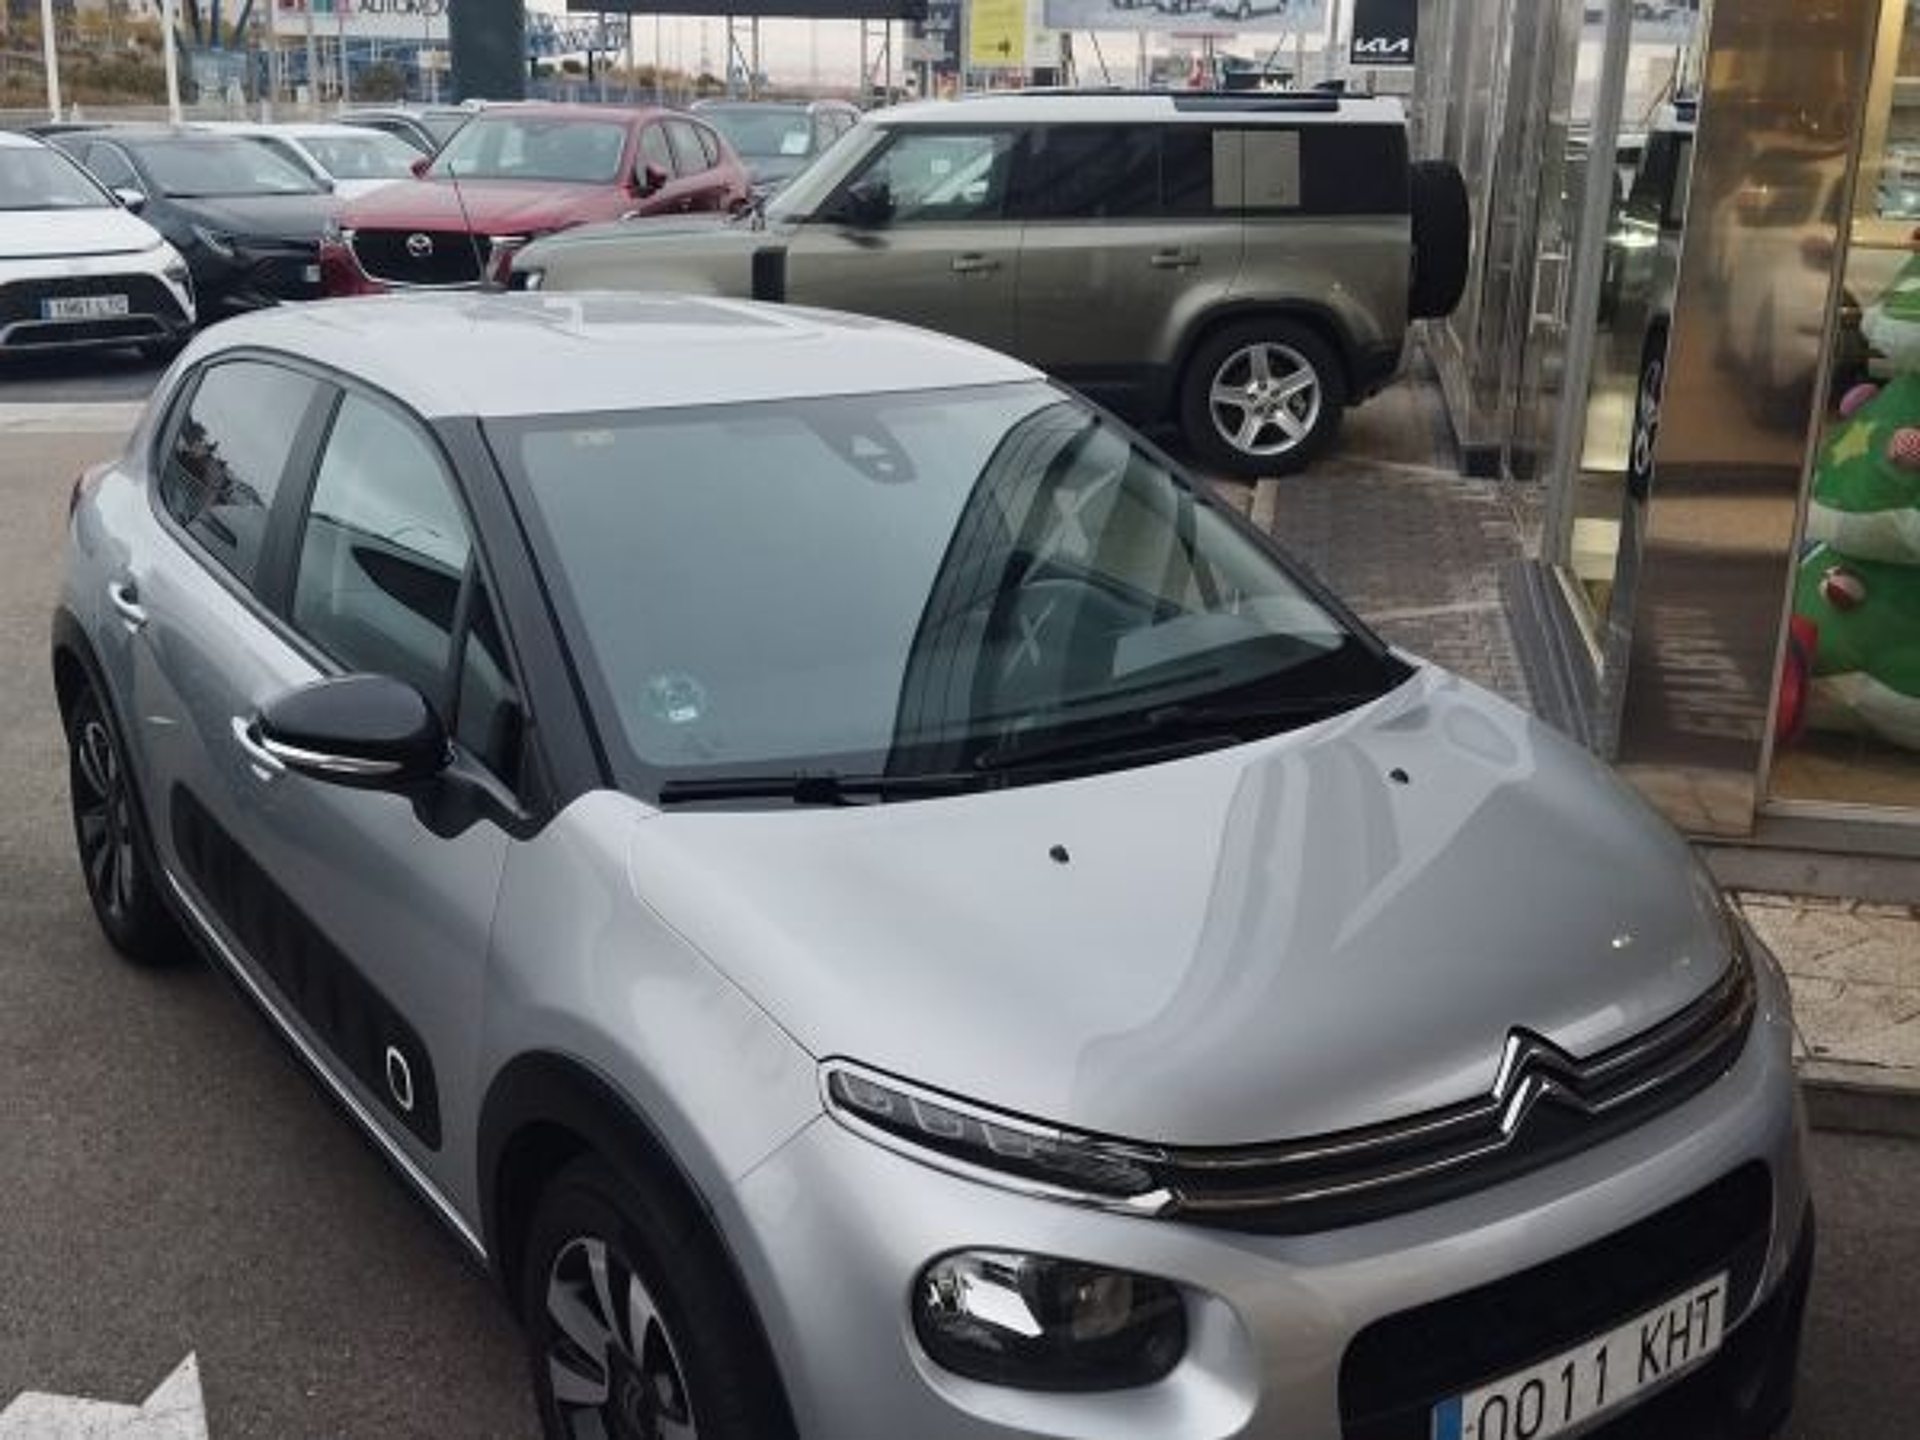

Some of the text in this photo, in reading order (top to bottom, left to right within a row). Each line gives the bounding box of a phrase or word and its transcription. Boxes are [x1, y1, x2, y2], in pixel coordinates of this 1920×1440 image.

[1355, 37, 1409, 52] KIA
[1478, 1286, 1720, 1440] 0011 KHT
